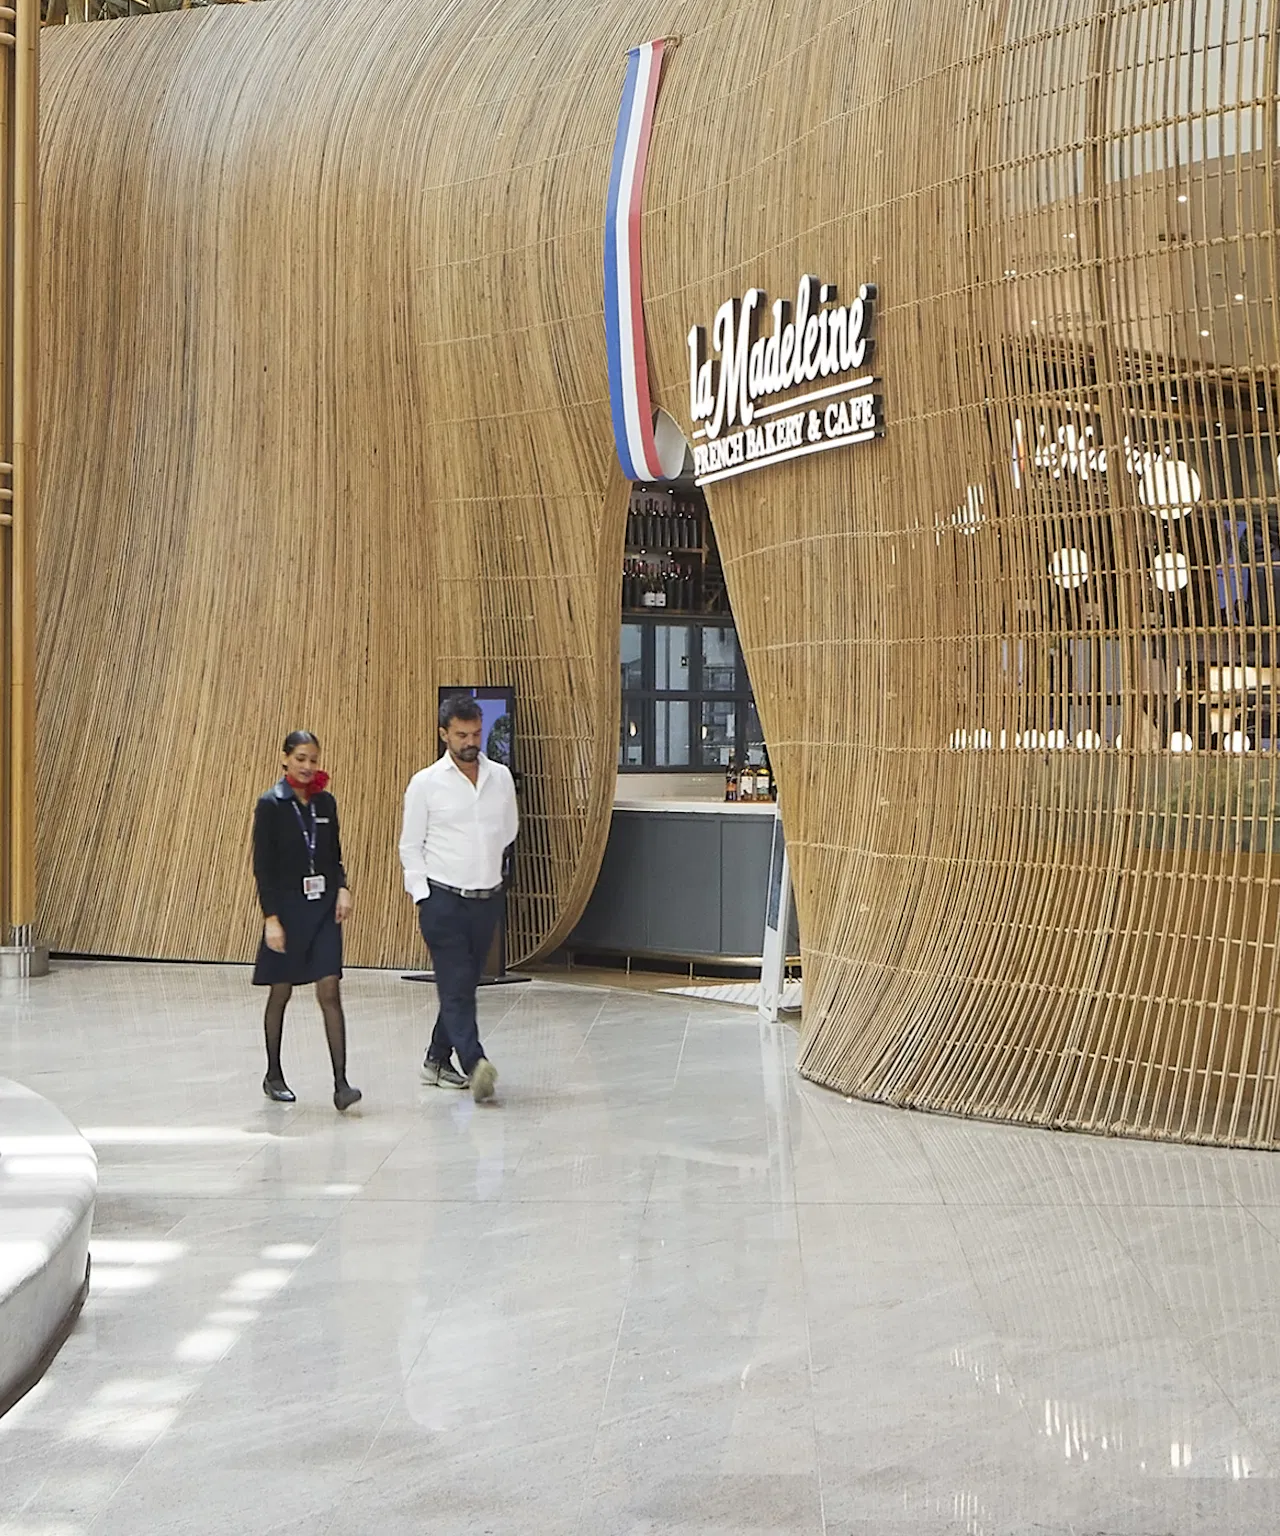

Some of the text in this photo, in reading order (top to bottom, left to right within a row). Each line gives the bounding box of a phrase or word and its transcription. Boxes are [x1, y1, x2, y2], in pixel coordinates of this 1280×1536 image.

[687, 273, 868, 440] la Madeleine
[693, 431, 745, 477] FRENCH
[745, 411, 806, 461] BAKERY
[807, 408, 822, 442] &
